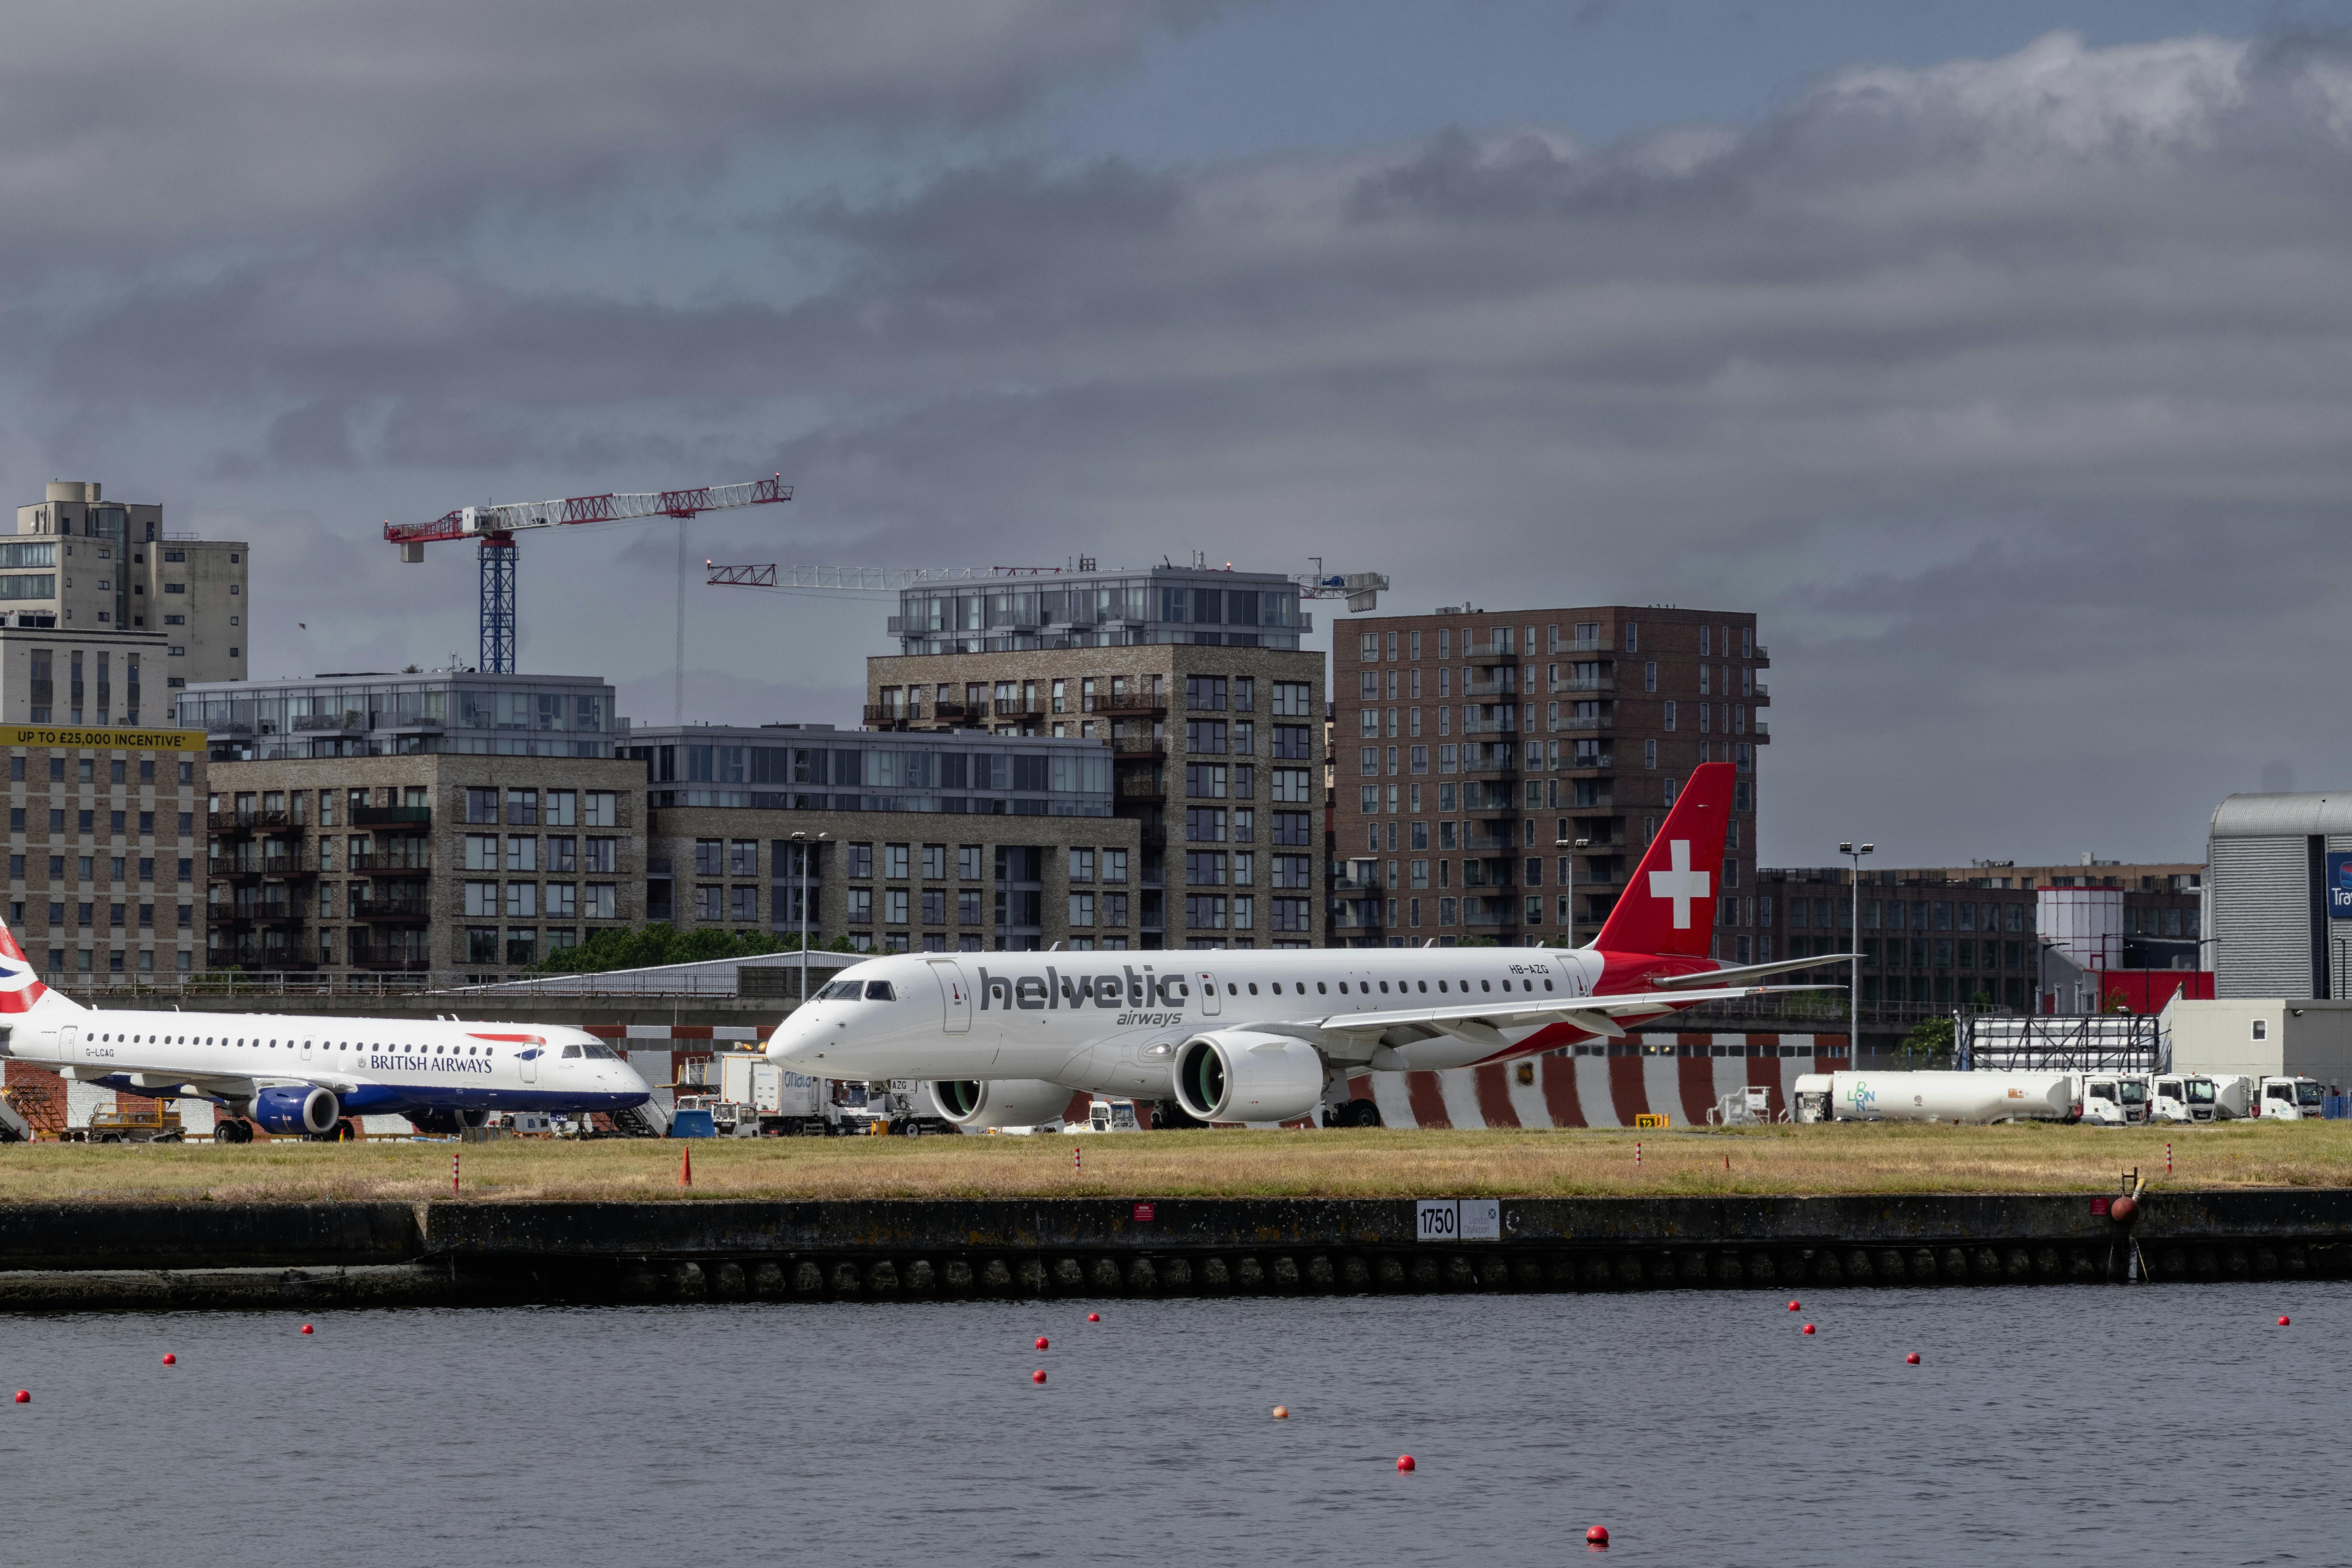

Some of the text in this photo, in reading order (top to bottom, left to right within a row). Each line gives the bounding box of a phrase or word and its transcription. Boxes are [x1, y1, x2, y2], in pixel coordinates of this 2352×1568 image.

[18, 731, 34, 742] UP
[38, 732, 55, 743] TO
[60, 733, 110, 746] £25,000
[1509, 965, 1549, 974] HB-AZG
[978, 965, 1185, 1010] helvetic
[1117, 1010, 1182, 1027] airways
[86, 1048, 114, 1057] G-LCAG
[371, 1055, 492, 1073] BRITISH AIRWAYS
[892, 1081, 906, 1089] AZG
[1421, 1208, 1454, 1234] 1750
